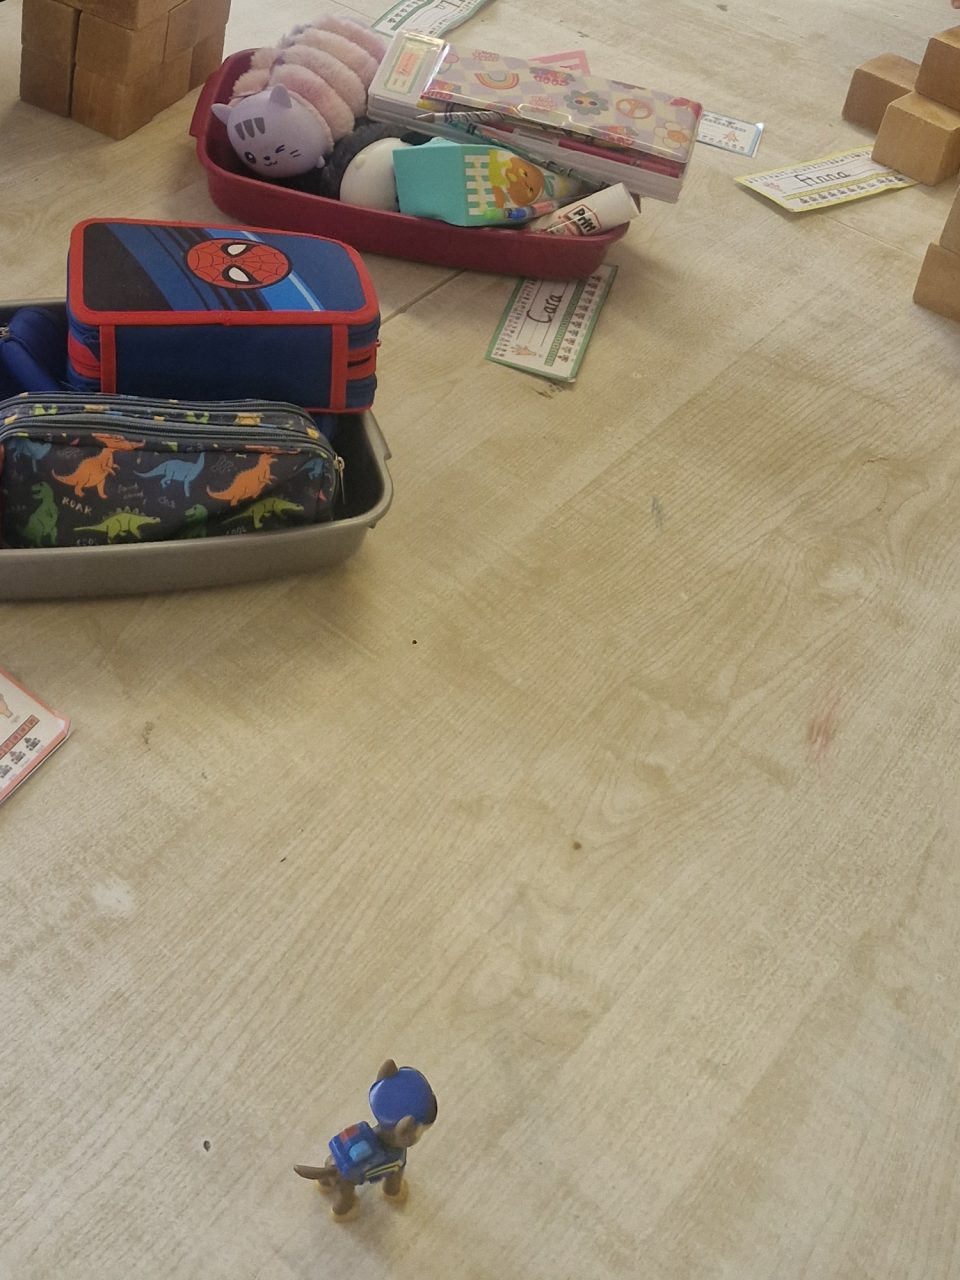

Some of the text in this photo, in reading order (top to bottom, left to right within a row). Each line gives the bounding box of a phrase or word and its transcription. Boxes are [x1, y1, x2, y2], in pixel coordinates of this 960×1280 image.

[794, 169, 851, 187] Anna
[526, 294, 563, 324] Cara
[62, 496, 93, 515] ROAR
